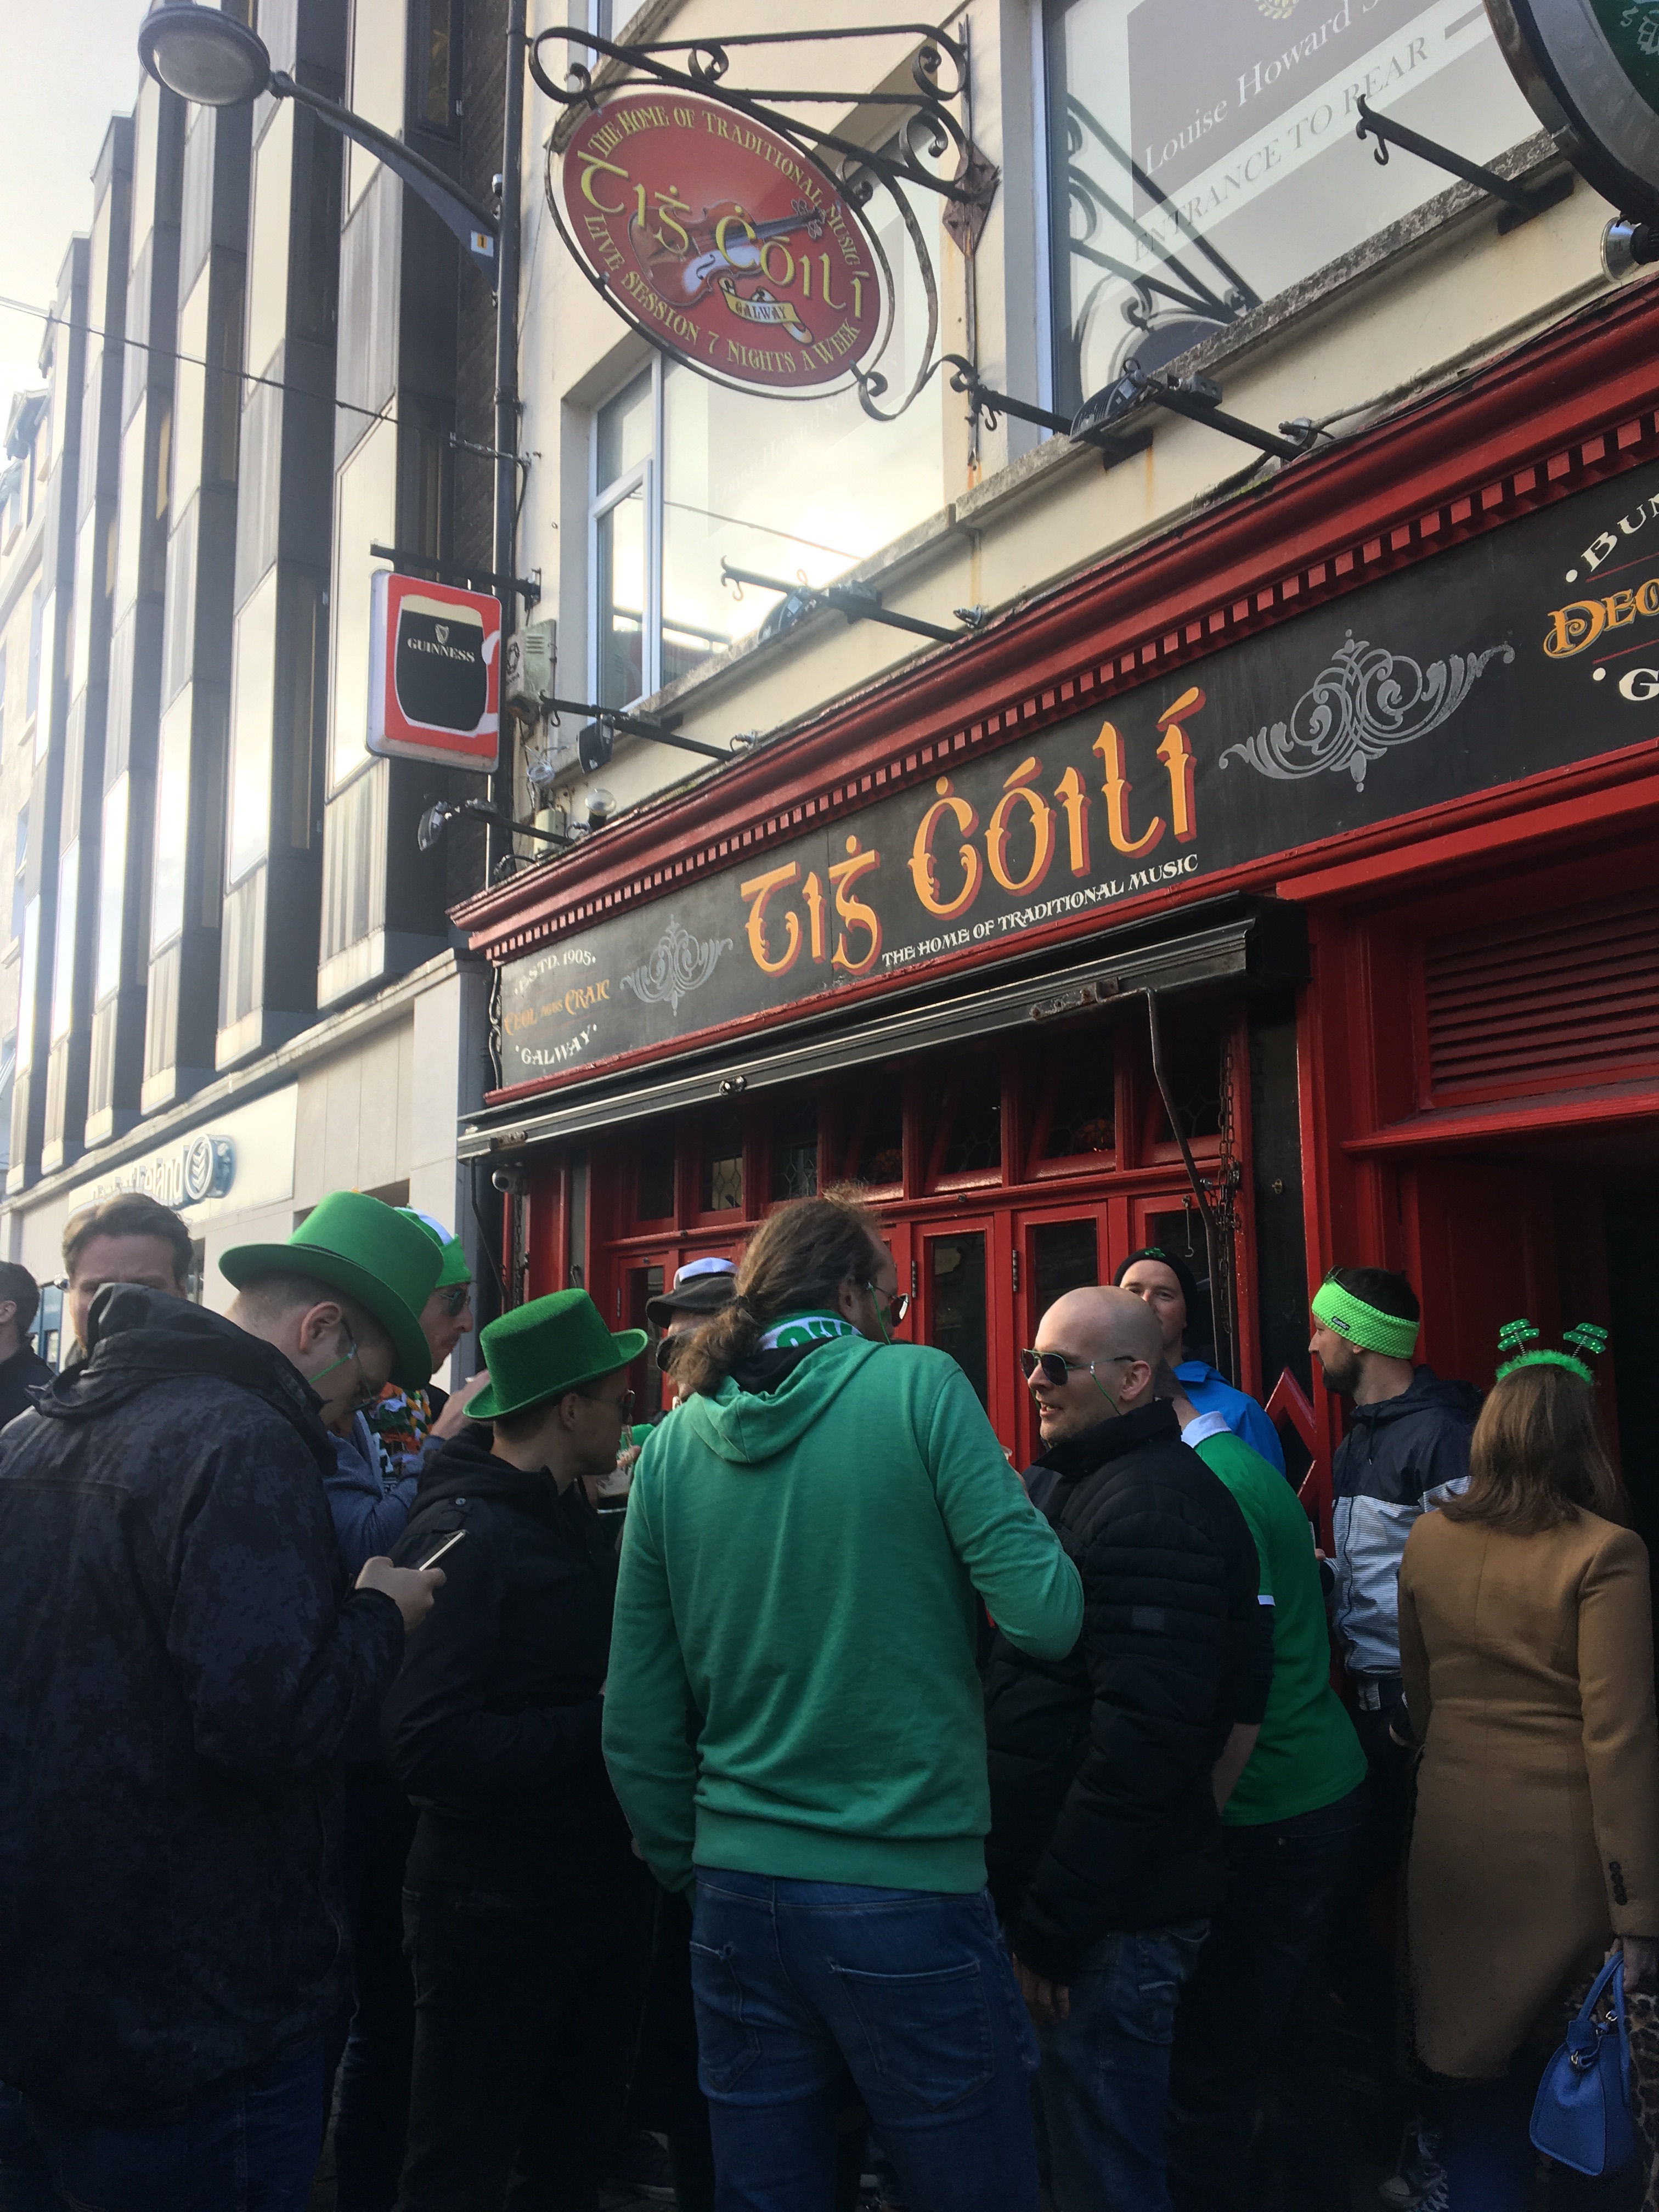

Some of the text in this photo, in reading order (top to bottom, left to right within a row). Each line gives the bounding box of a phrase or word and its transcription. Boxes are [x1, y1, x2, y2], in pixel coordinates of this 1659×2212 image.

[1146, 0, 1351, 177] Louise Howard
[587, 106, 862, 266] THE HOME OF TRADITIONAL MUSIC
[1133, 36, 1427, 262] ENTRANCE TO REAR
[583, 214, 861, 373] LIVE SESSION 7 NIGHTS A WEEK
[736, 301, 787, 320] GALWAY
[408, 637, 475, 663] GUINNESS
[882, 854, 1199, 968] THE HOME OF TRADITIONAL MUSIC
[521, 1025, 591, 1065] GALWAY
[565, 979, 610, 1015] CRAIC
